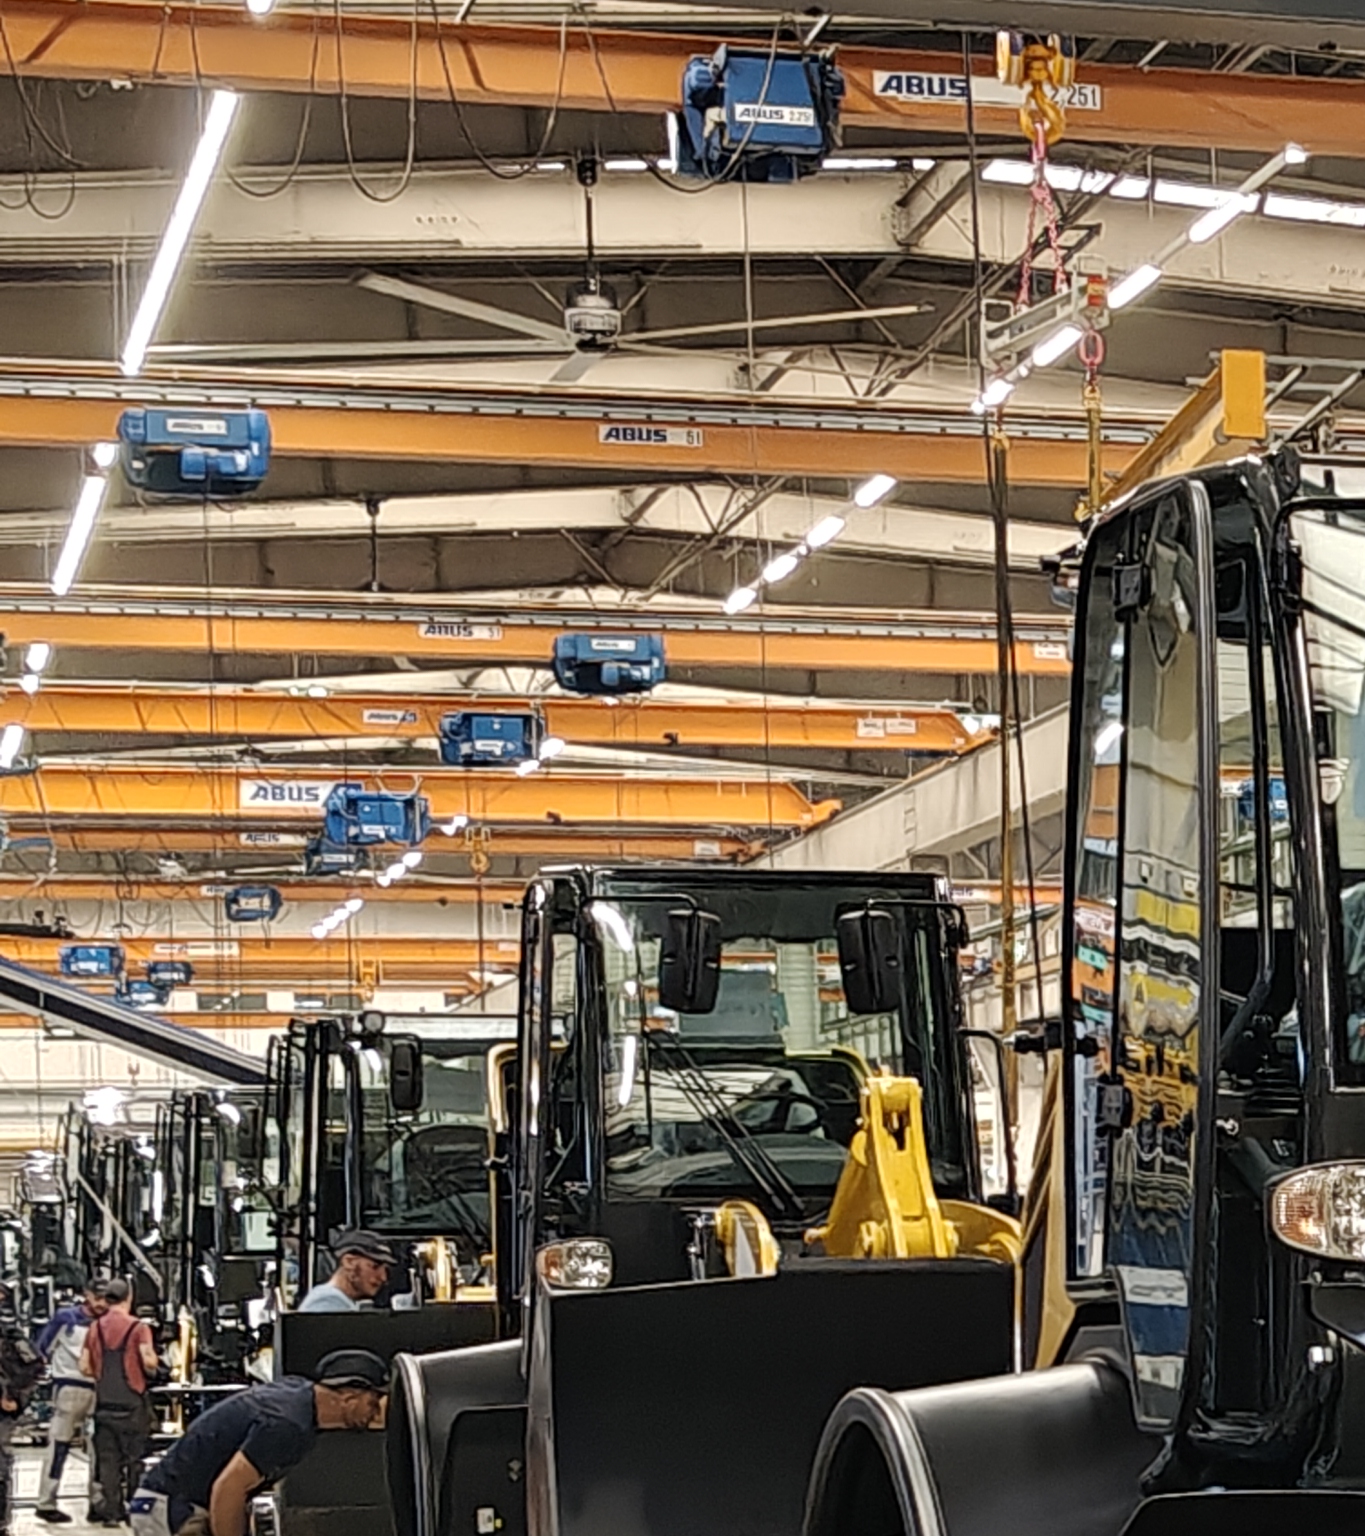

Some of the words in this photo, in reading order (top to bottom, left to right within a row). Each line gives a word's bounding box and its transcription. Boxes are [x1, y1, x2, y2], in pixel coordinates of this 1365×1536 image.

[880, 74, 968, 97] ABUS
[603, 427, 667, 442] ABUS
[250, 785, 320, 802] ABUS
